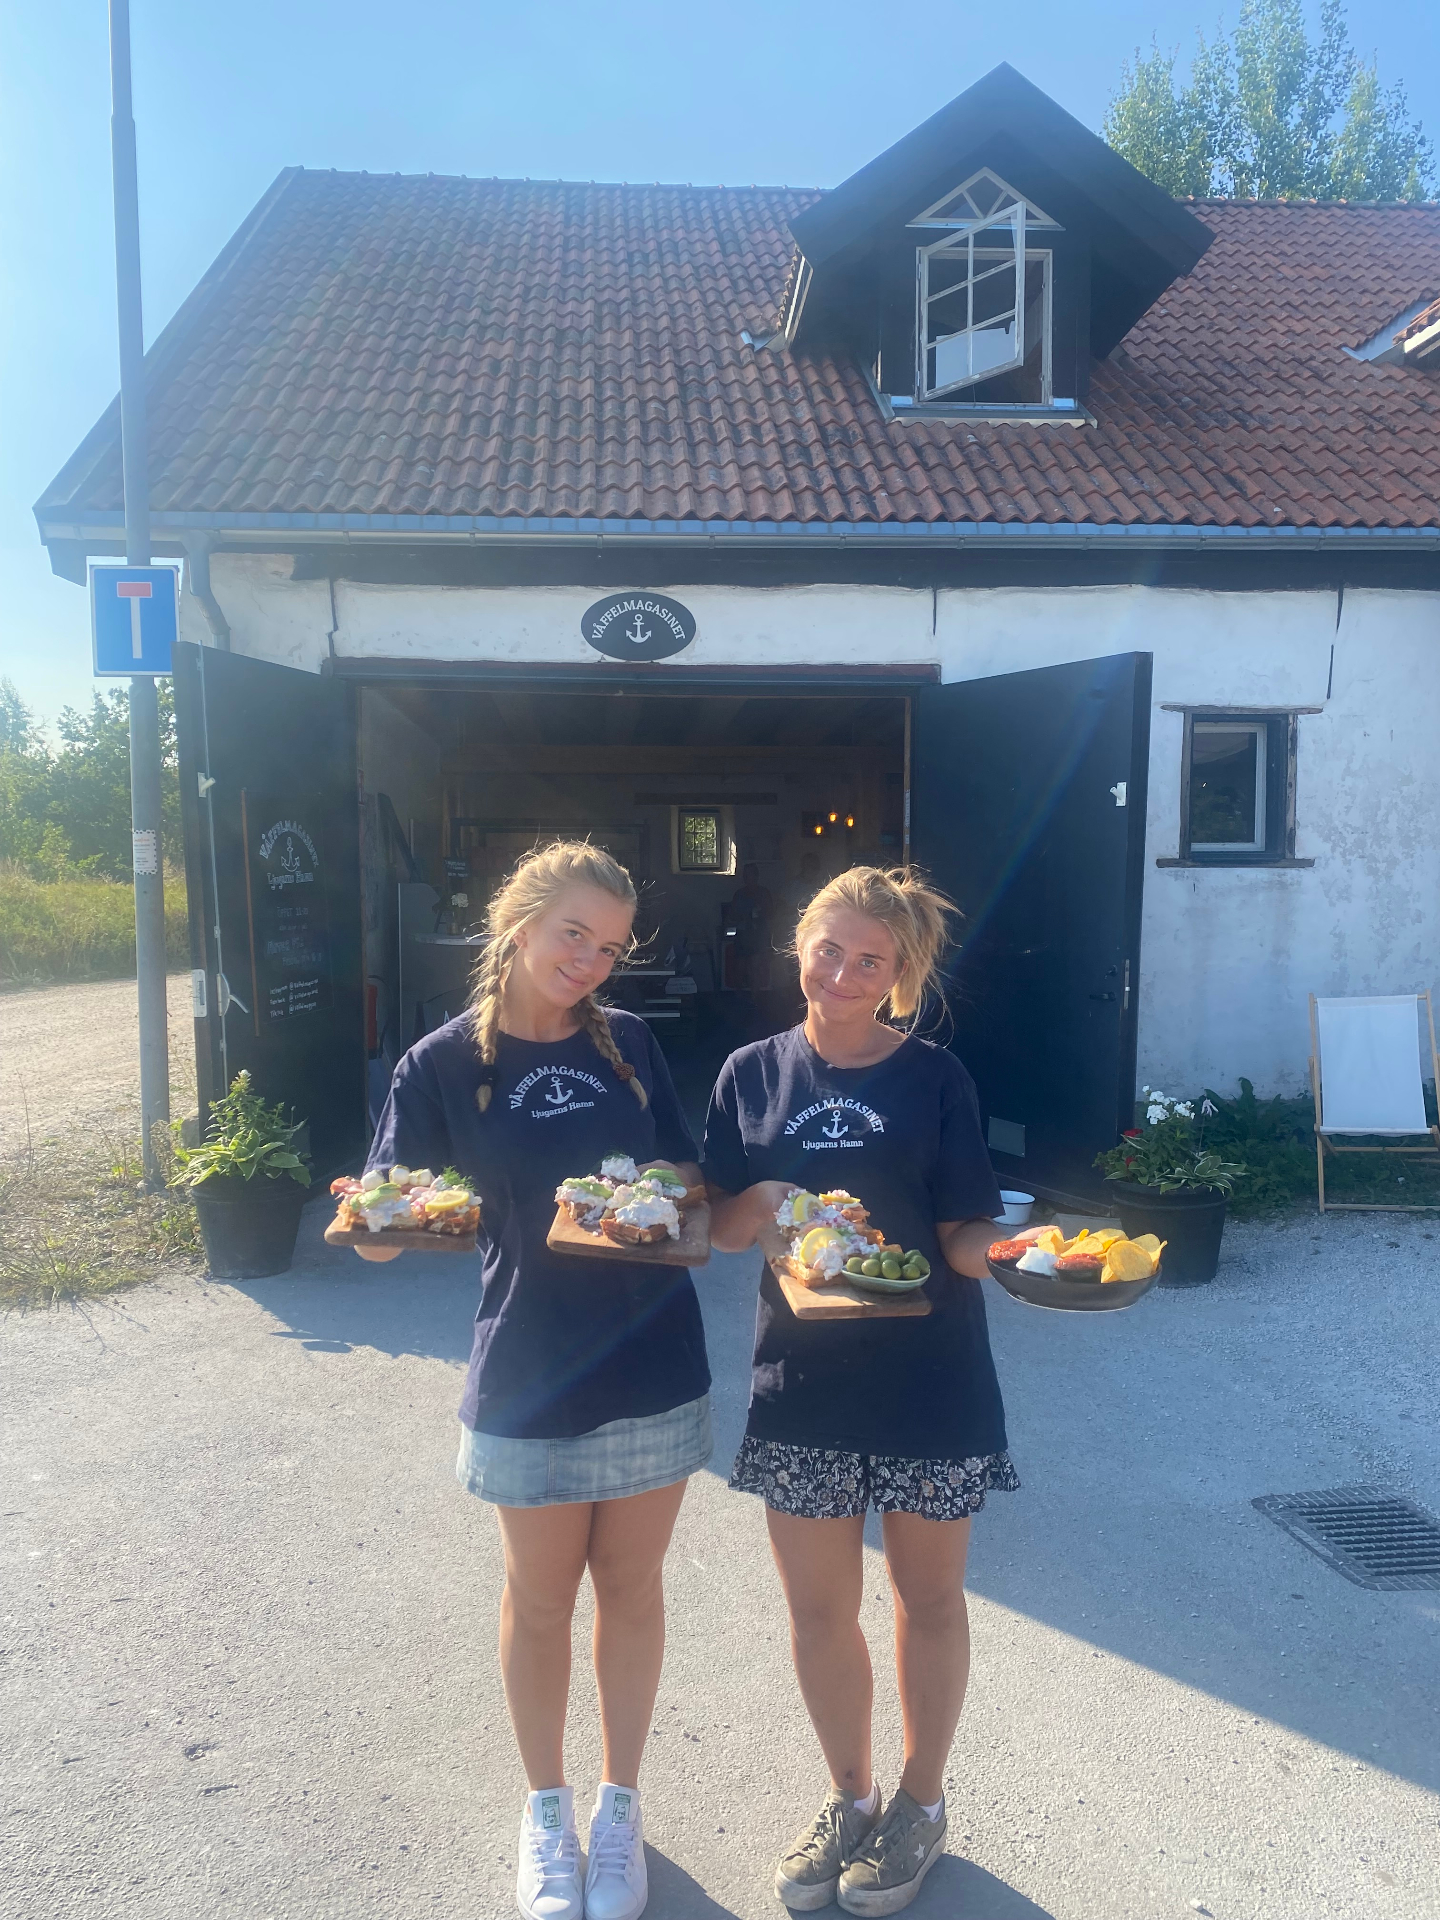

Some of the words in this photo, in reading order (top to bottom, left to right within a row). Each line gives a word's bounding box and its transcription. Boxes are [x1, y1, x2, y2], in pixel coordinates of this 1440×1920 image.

[591, 599, 686, 640] VÅFFELMAGASINET
[508, 1065, 608, 1110] VÅFFELMAGASINET
[531, 1105, 568, 1119] Ljugarns
[568, 1101, 594, 1111] Hamn
[784, 1097, 885, 1134] VÅFFELMAGASINET
[802, 1140, 838, 1151] Ljugarns
[840, 1140, 864, 1148] Hamn
